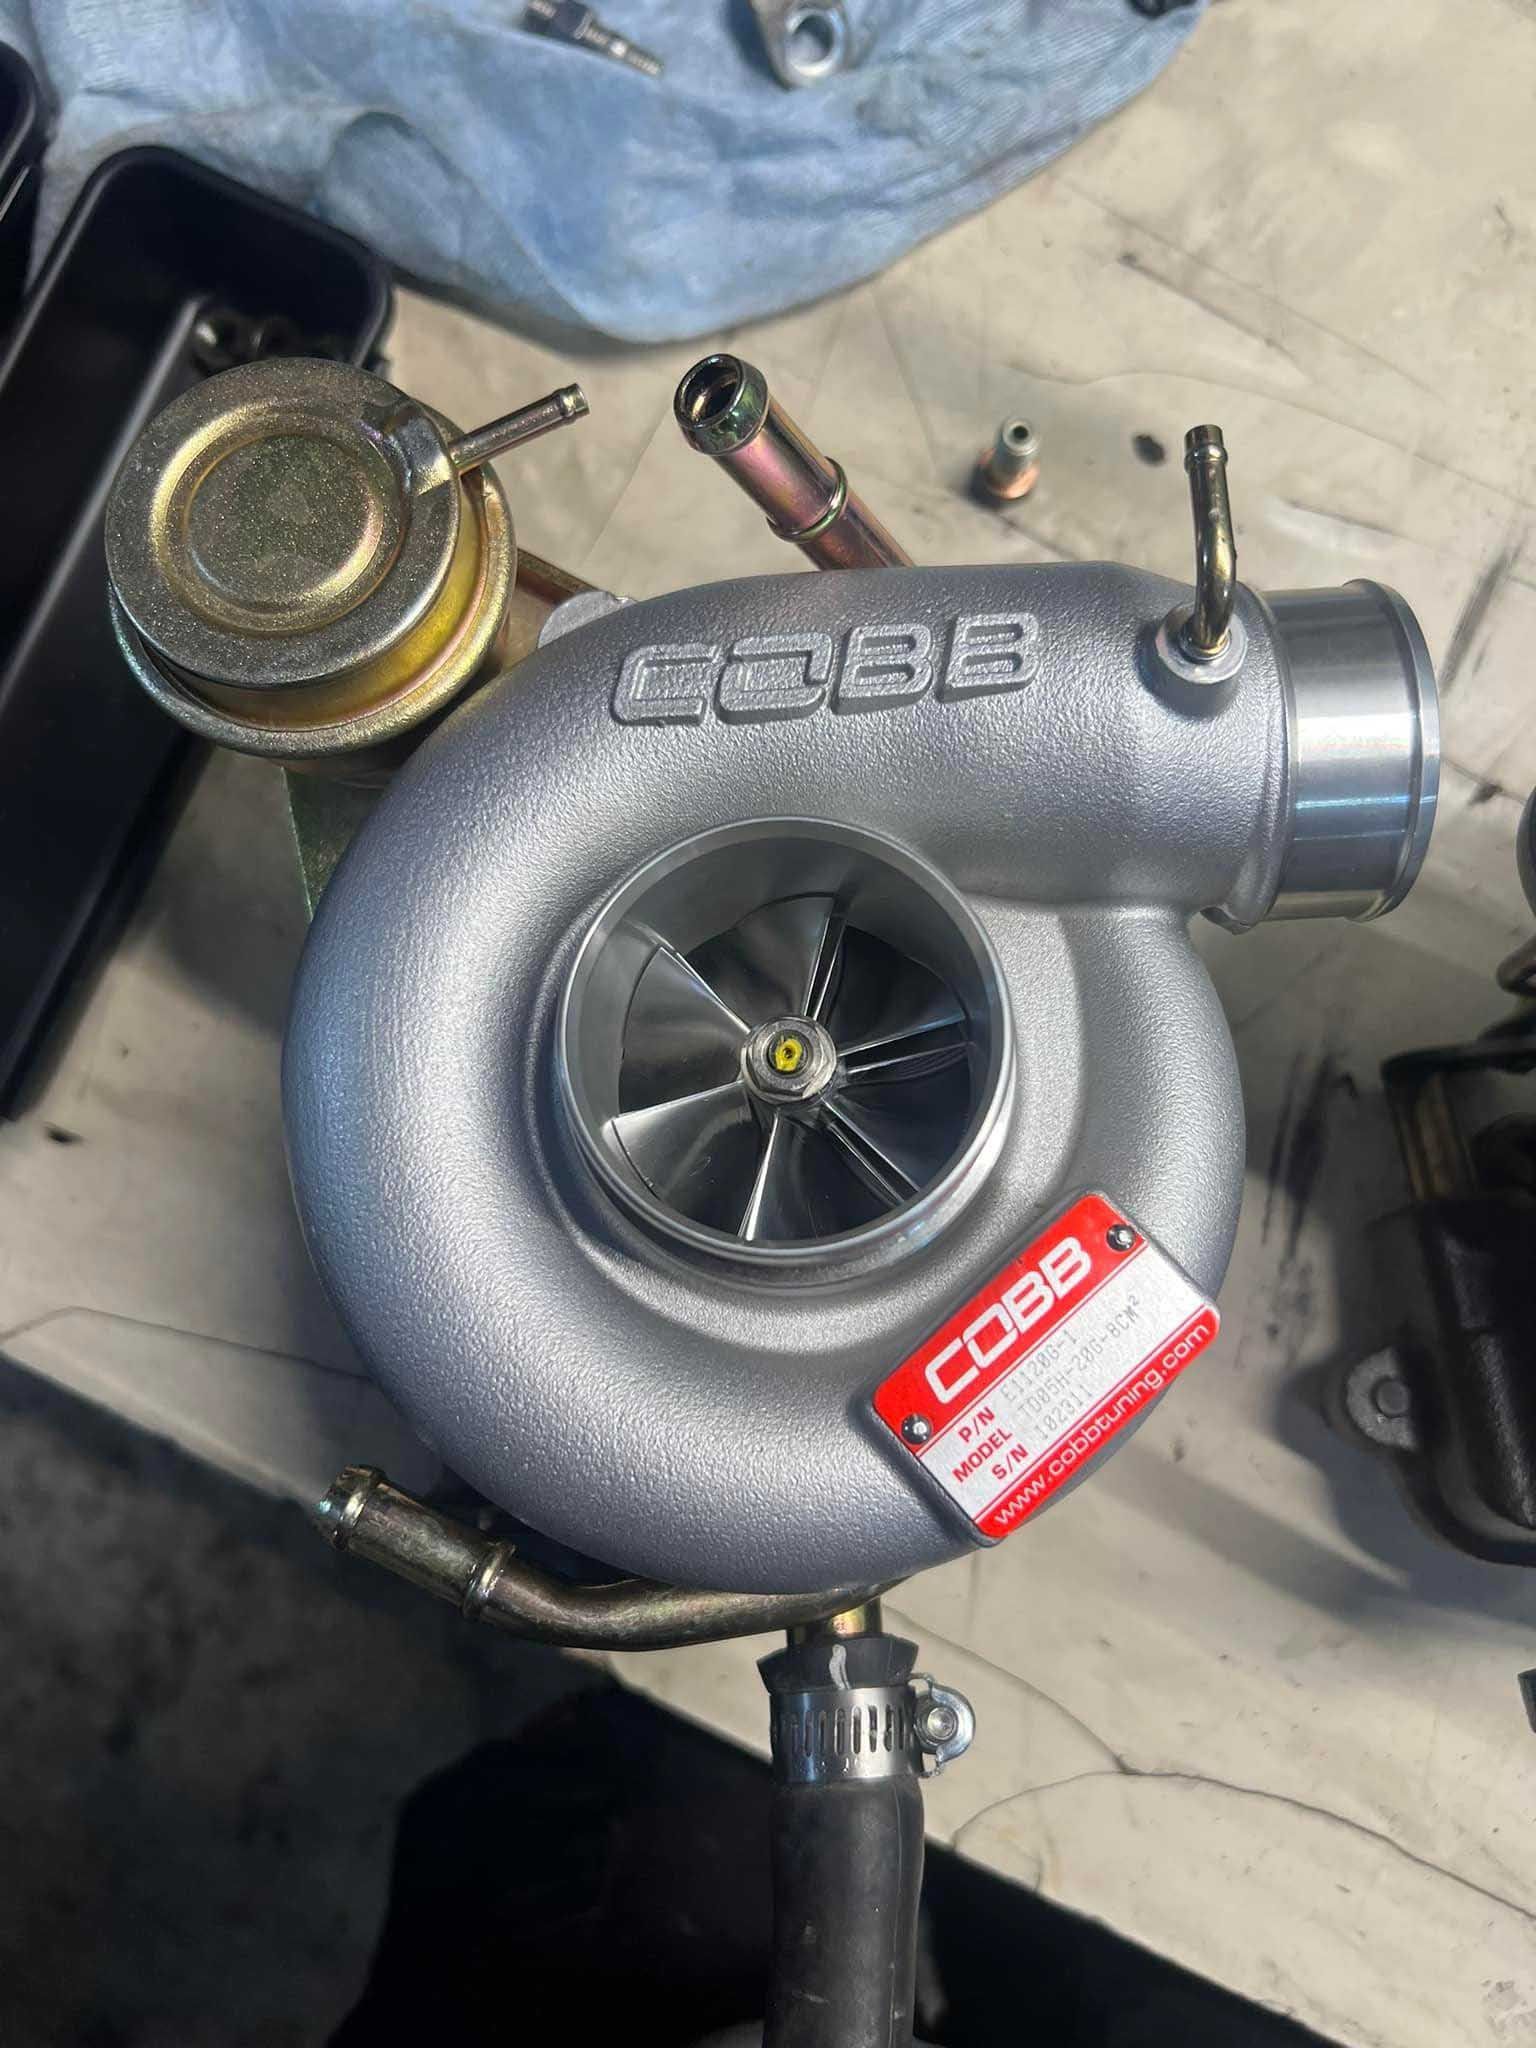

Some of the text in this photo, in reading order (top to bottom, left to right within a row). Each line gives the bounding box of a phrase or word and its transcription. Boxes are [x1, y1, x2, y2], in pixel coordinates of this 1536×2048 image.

[610, 612, 1040, 727] COBB
[925, 1237, 1092, 1404] COBB
[952, 1429, 1013, 1484] MODEL
[958, 1406, 996, 1443] P/N
[991, 1443, 1029, 1481] S/N
[995, 1324, 1209, 1525] www.cobbtuning.com
